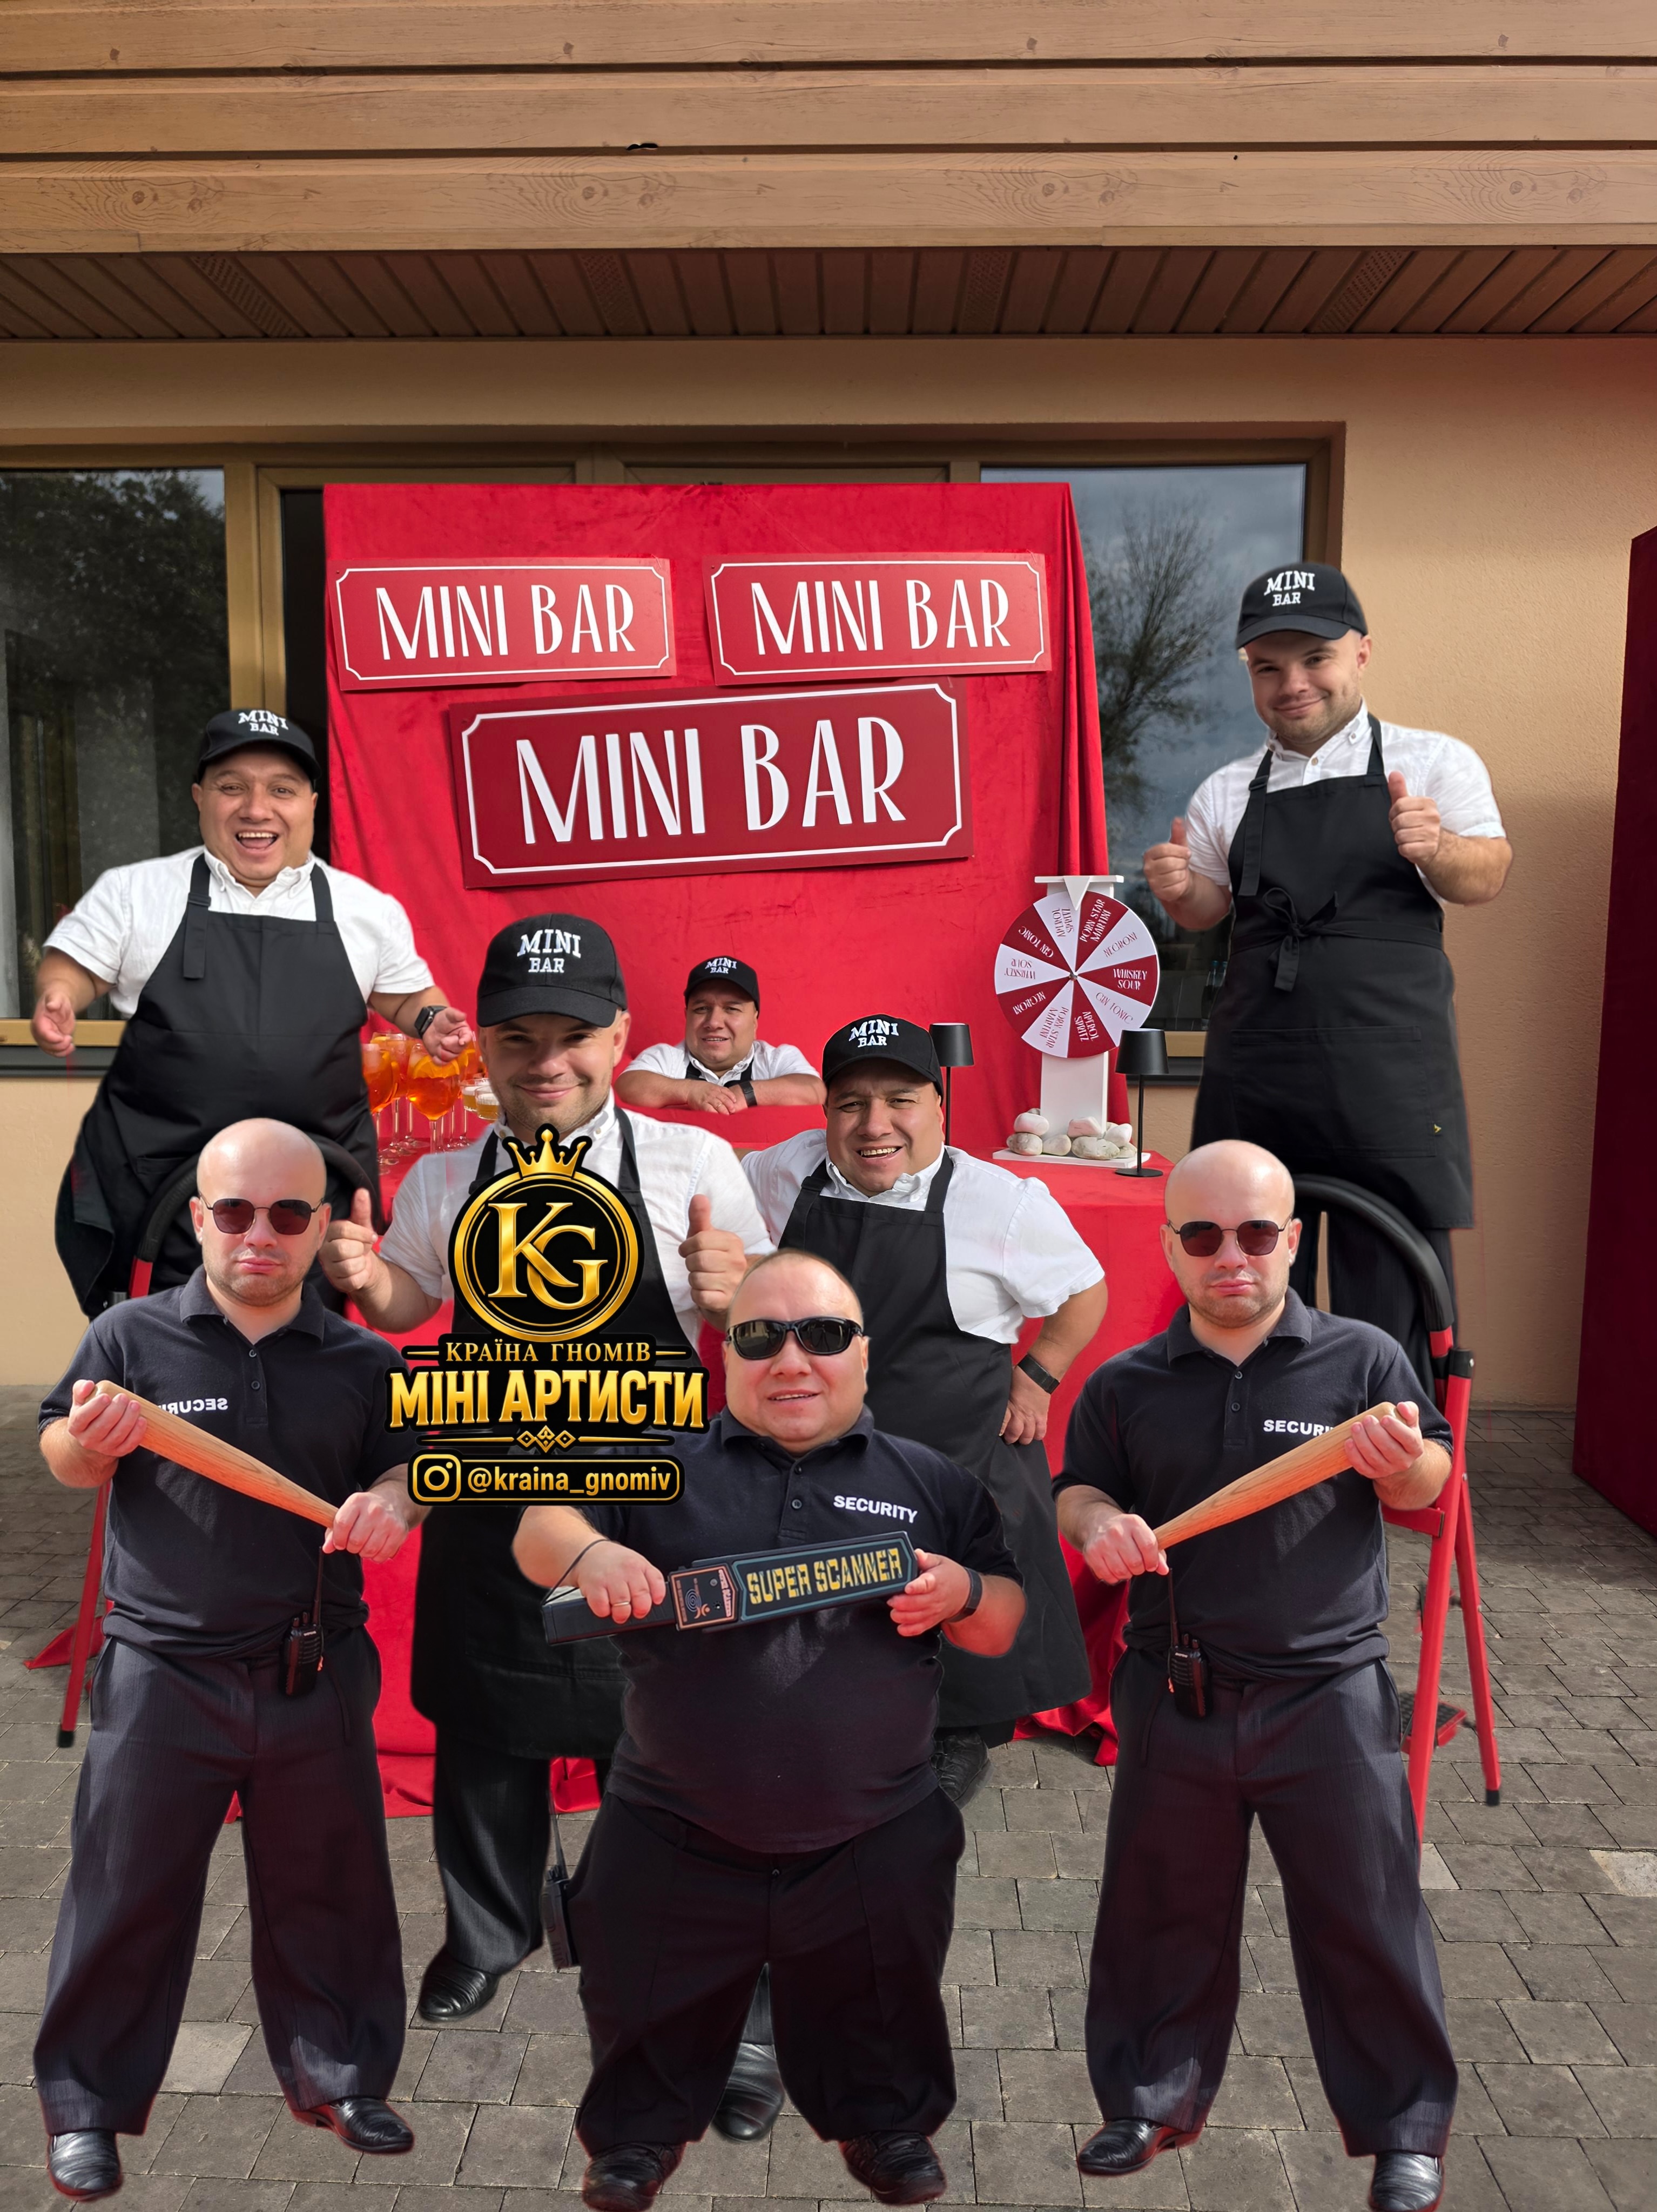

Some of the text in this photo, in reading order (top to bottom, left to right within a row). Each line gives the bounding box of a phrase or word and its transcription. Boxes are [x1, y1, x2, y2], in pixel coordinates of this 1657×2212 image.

[1264, 570, 1315, 596] MINI
[1272, 592, 1301, 606] BAR
[376, 584, 636, 660] MINI BAR
[751, 578, 1012, 655] MINI BAR
[238, 710, 289, 730] MINI
[250, 723, 279, 736] BAR
[516, 717, 906, 844] MINI BAR
[1079, 899, 1105, 942] PORN STAR
[1090, 909, 1112, 942] MARTINI
[517, 929, 581, 958] MINI
[1019, 926, 1054, 958] GIN TONIC
[1104, 932, 1138, 957] NEGRONI
[528, 957, 564, 973] BAR
[704, 957, 737, 969] MINI
[1113, 968, 1148, 980] WHISKEY
[1117, 979, 1141, 990] SOUR
[1095, 992, 1133, 1024] GIN TONIC
[848, 1019, 899, 1041] MINI
[1046, 1029, 1059, 1049] STAR
[1082, 1011, 1099, 1042] APEROL
[858, 1035, 887, 1048] BAR
[1263, 1419, 1335, 1437] SECUR
[833, 1495, 918, 1523] SECURITY
[746, 1563, 812, 1604] SUPER
[814, 1548, 903, 1593] SCANNER
